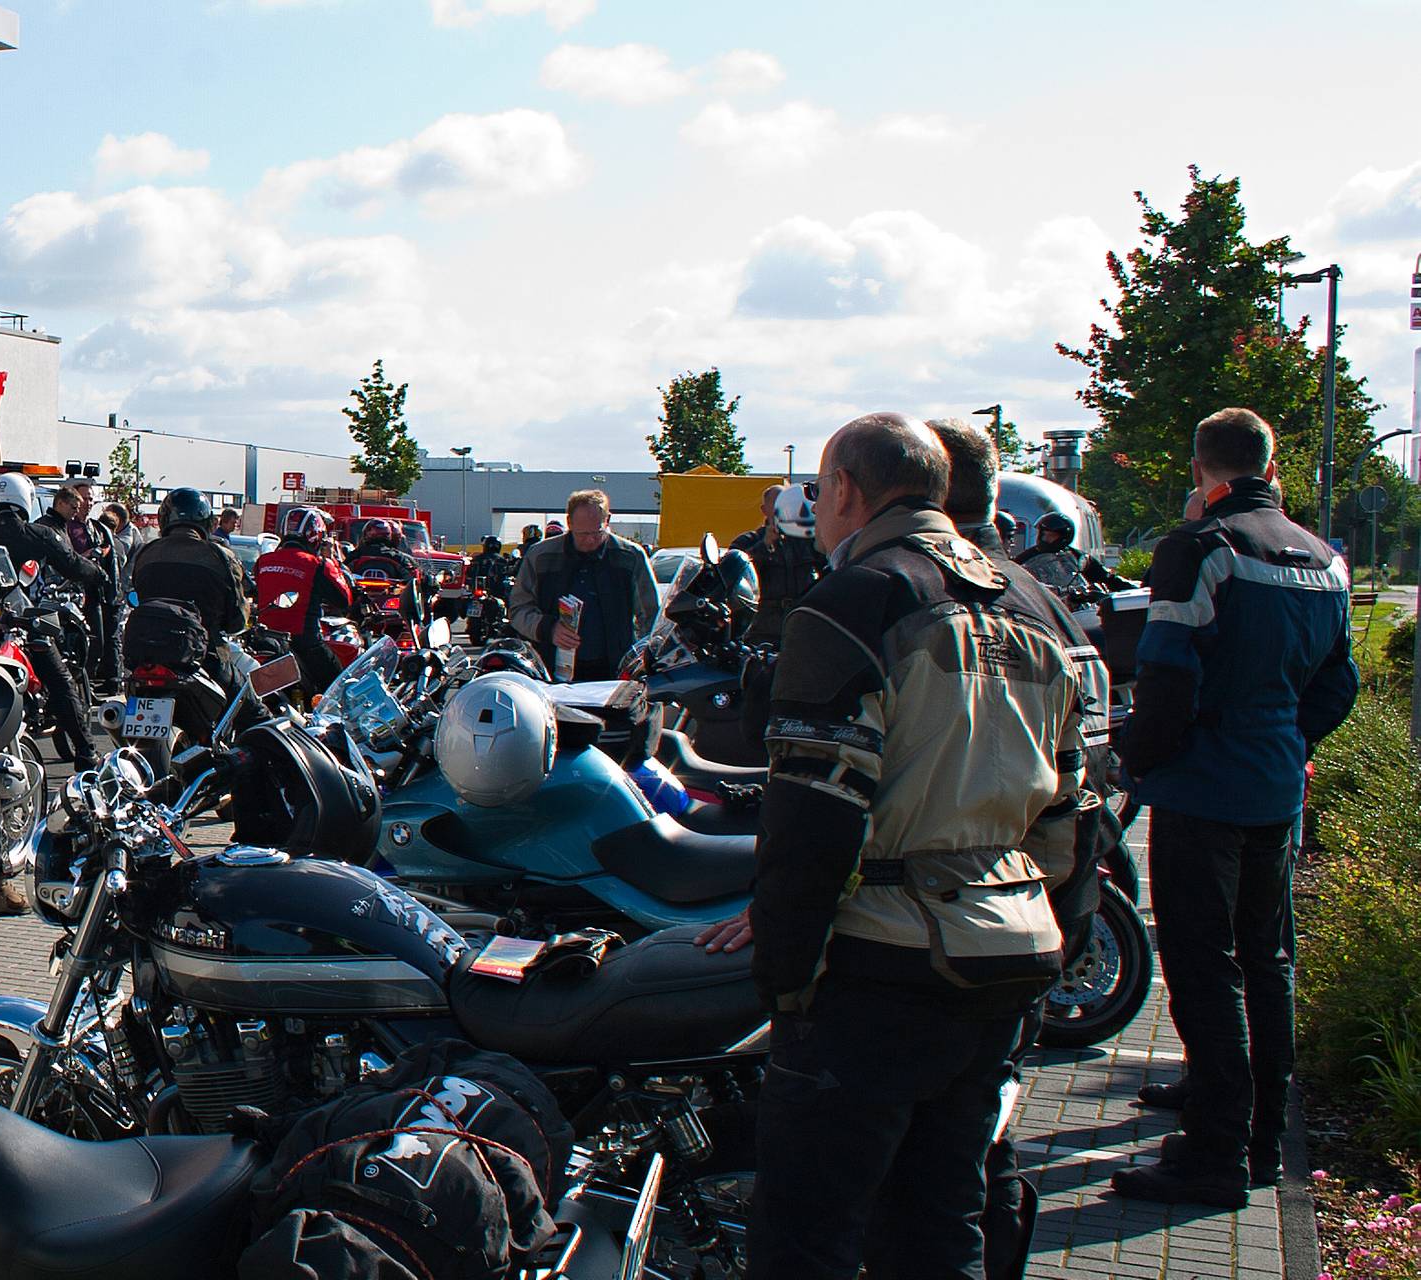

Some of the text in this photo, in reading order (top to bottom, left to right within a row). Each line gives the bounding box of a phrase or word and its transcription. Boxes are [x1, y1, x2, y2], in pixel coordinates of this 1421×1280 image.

[137, 699, 154, 710] NE
[125, 724, 168, 737] PF 979
